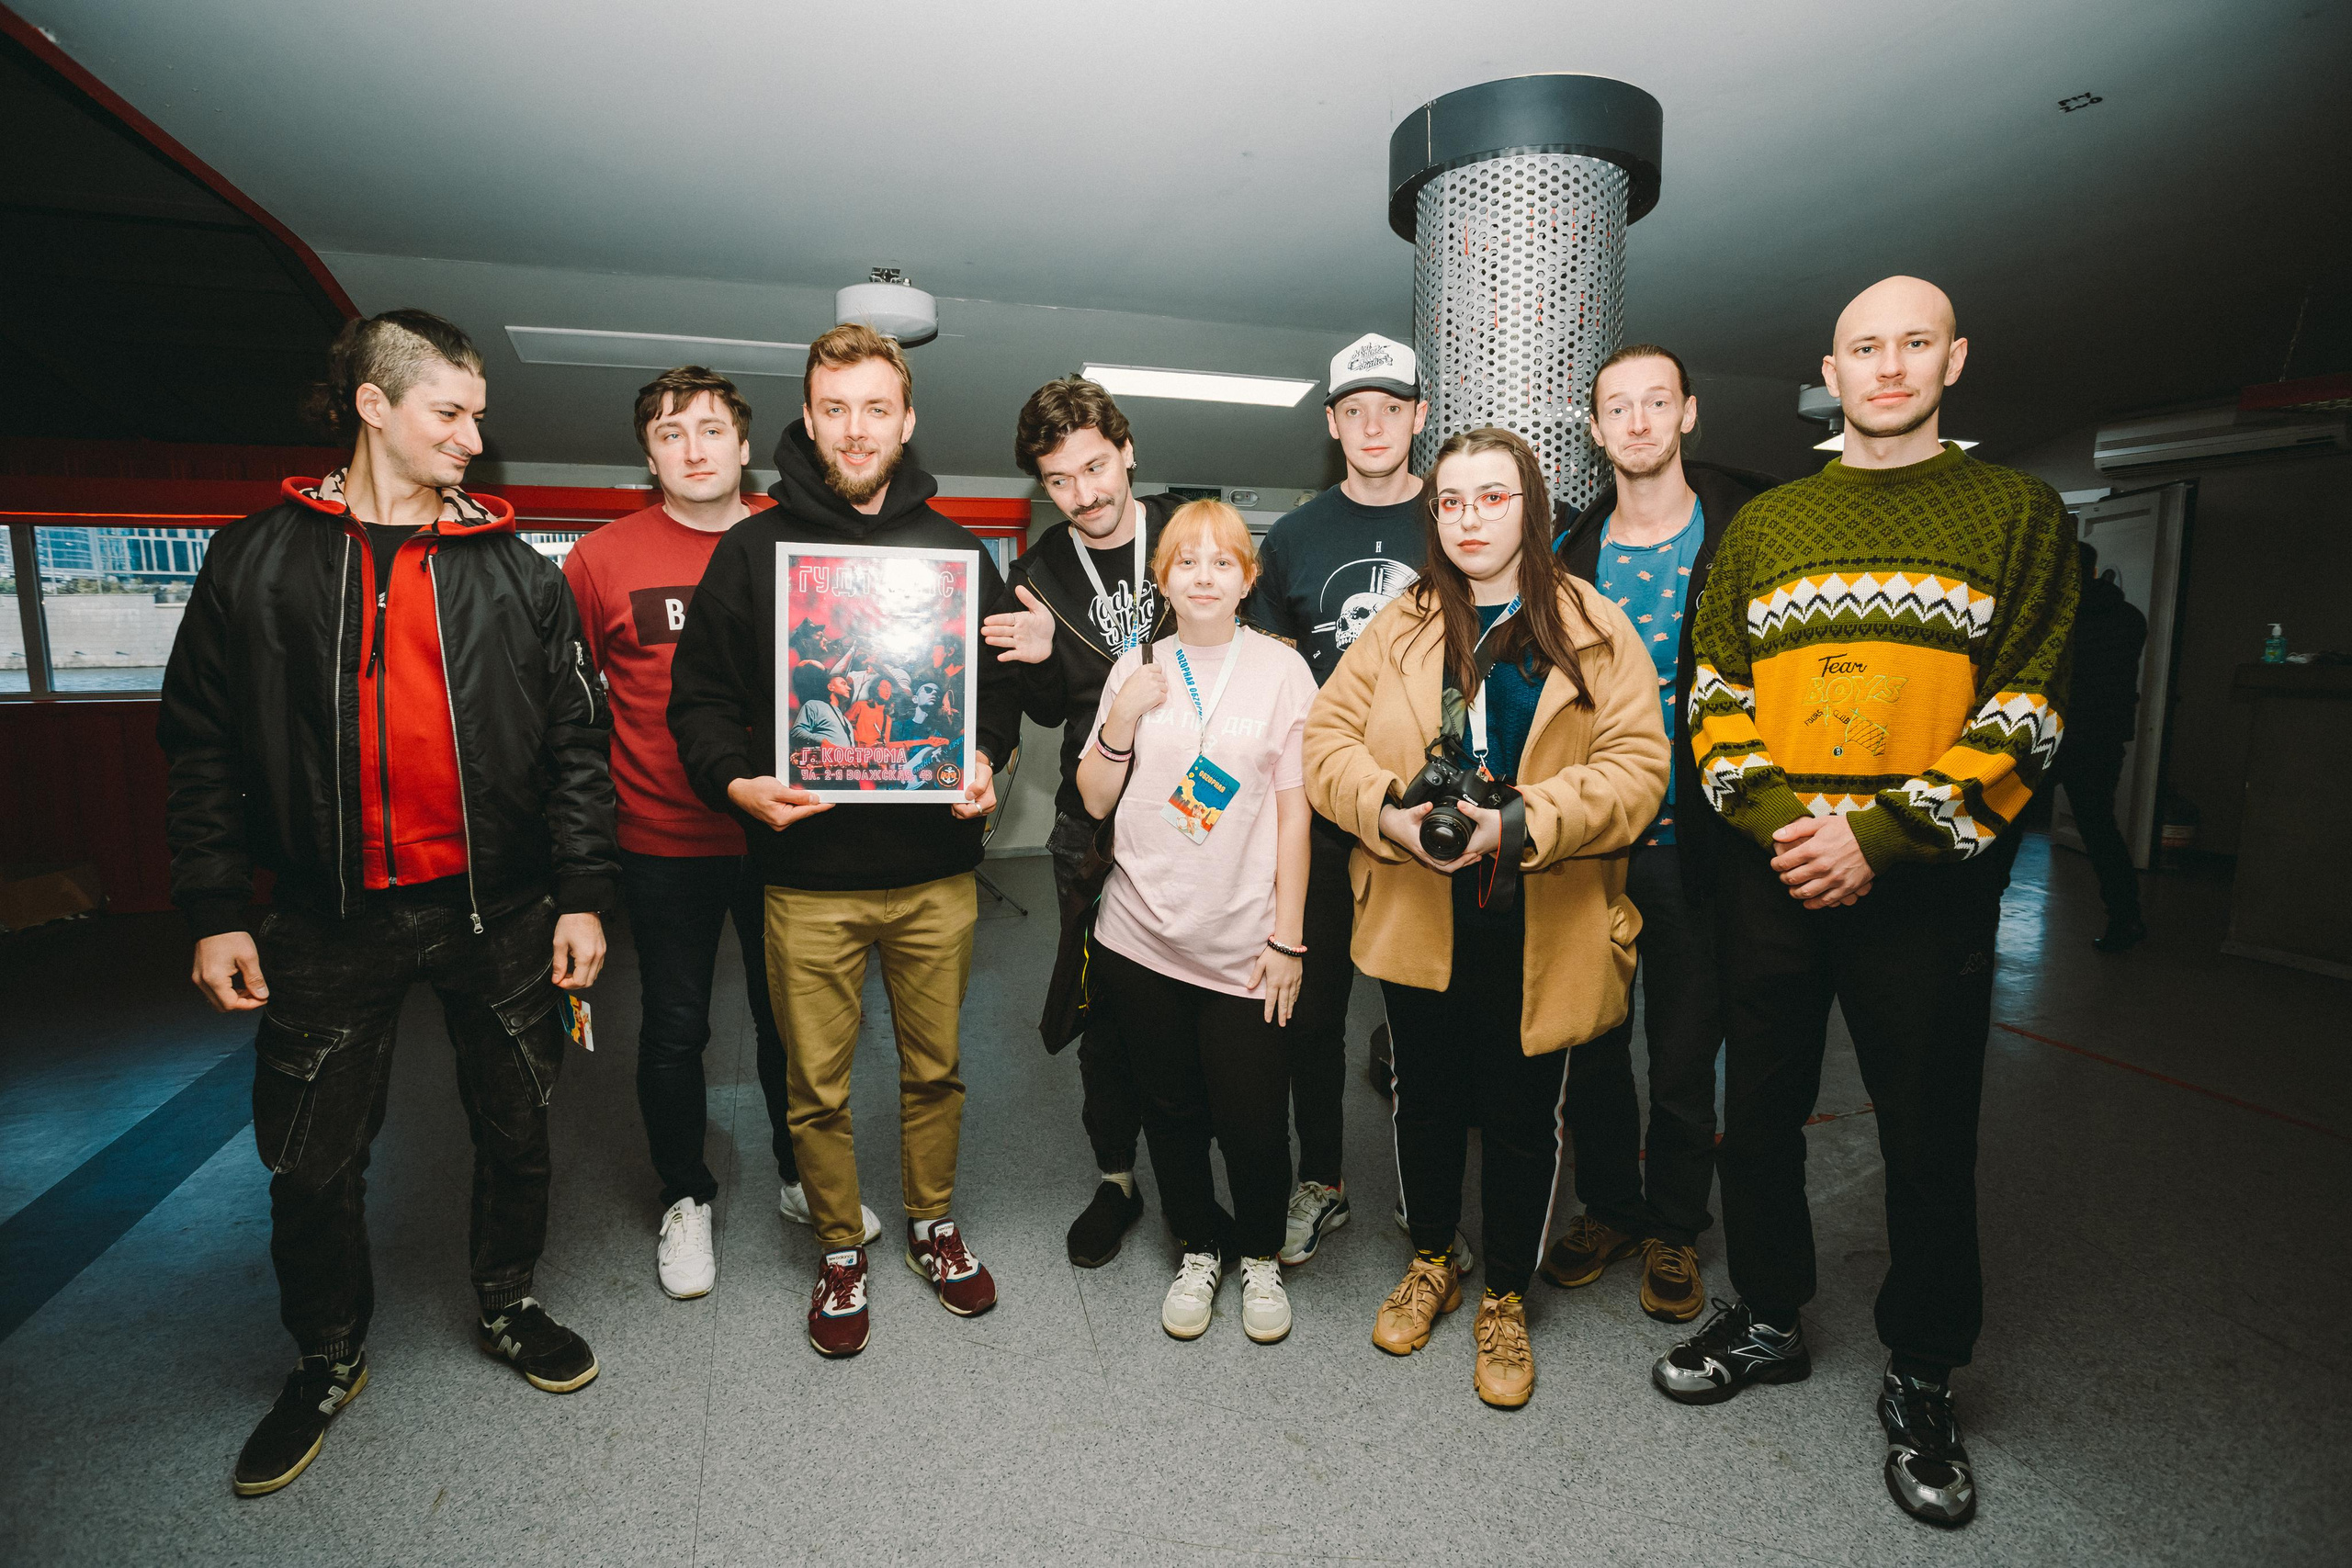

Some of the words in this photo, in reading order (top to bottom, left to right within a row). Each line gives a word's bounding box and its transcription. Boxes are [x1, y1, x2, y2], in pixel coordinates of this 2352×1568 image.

[1182, 490, 1209, 499] ВЫХОД
[664, 598, 686, 631] B
[1802, 675, 1909, 705] BOYS
[1833, 709, 1850, 725] CLUB
[821, 747, 908, 764] КОСТРОМА
[800, 769, 820, 781] УЛ.
[824, 769, 843, 781] 2-Я
[1463, 794, 1478, 807] Canon
